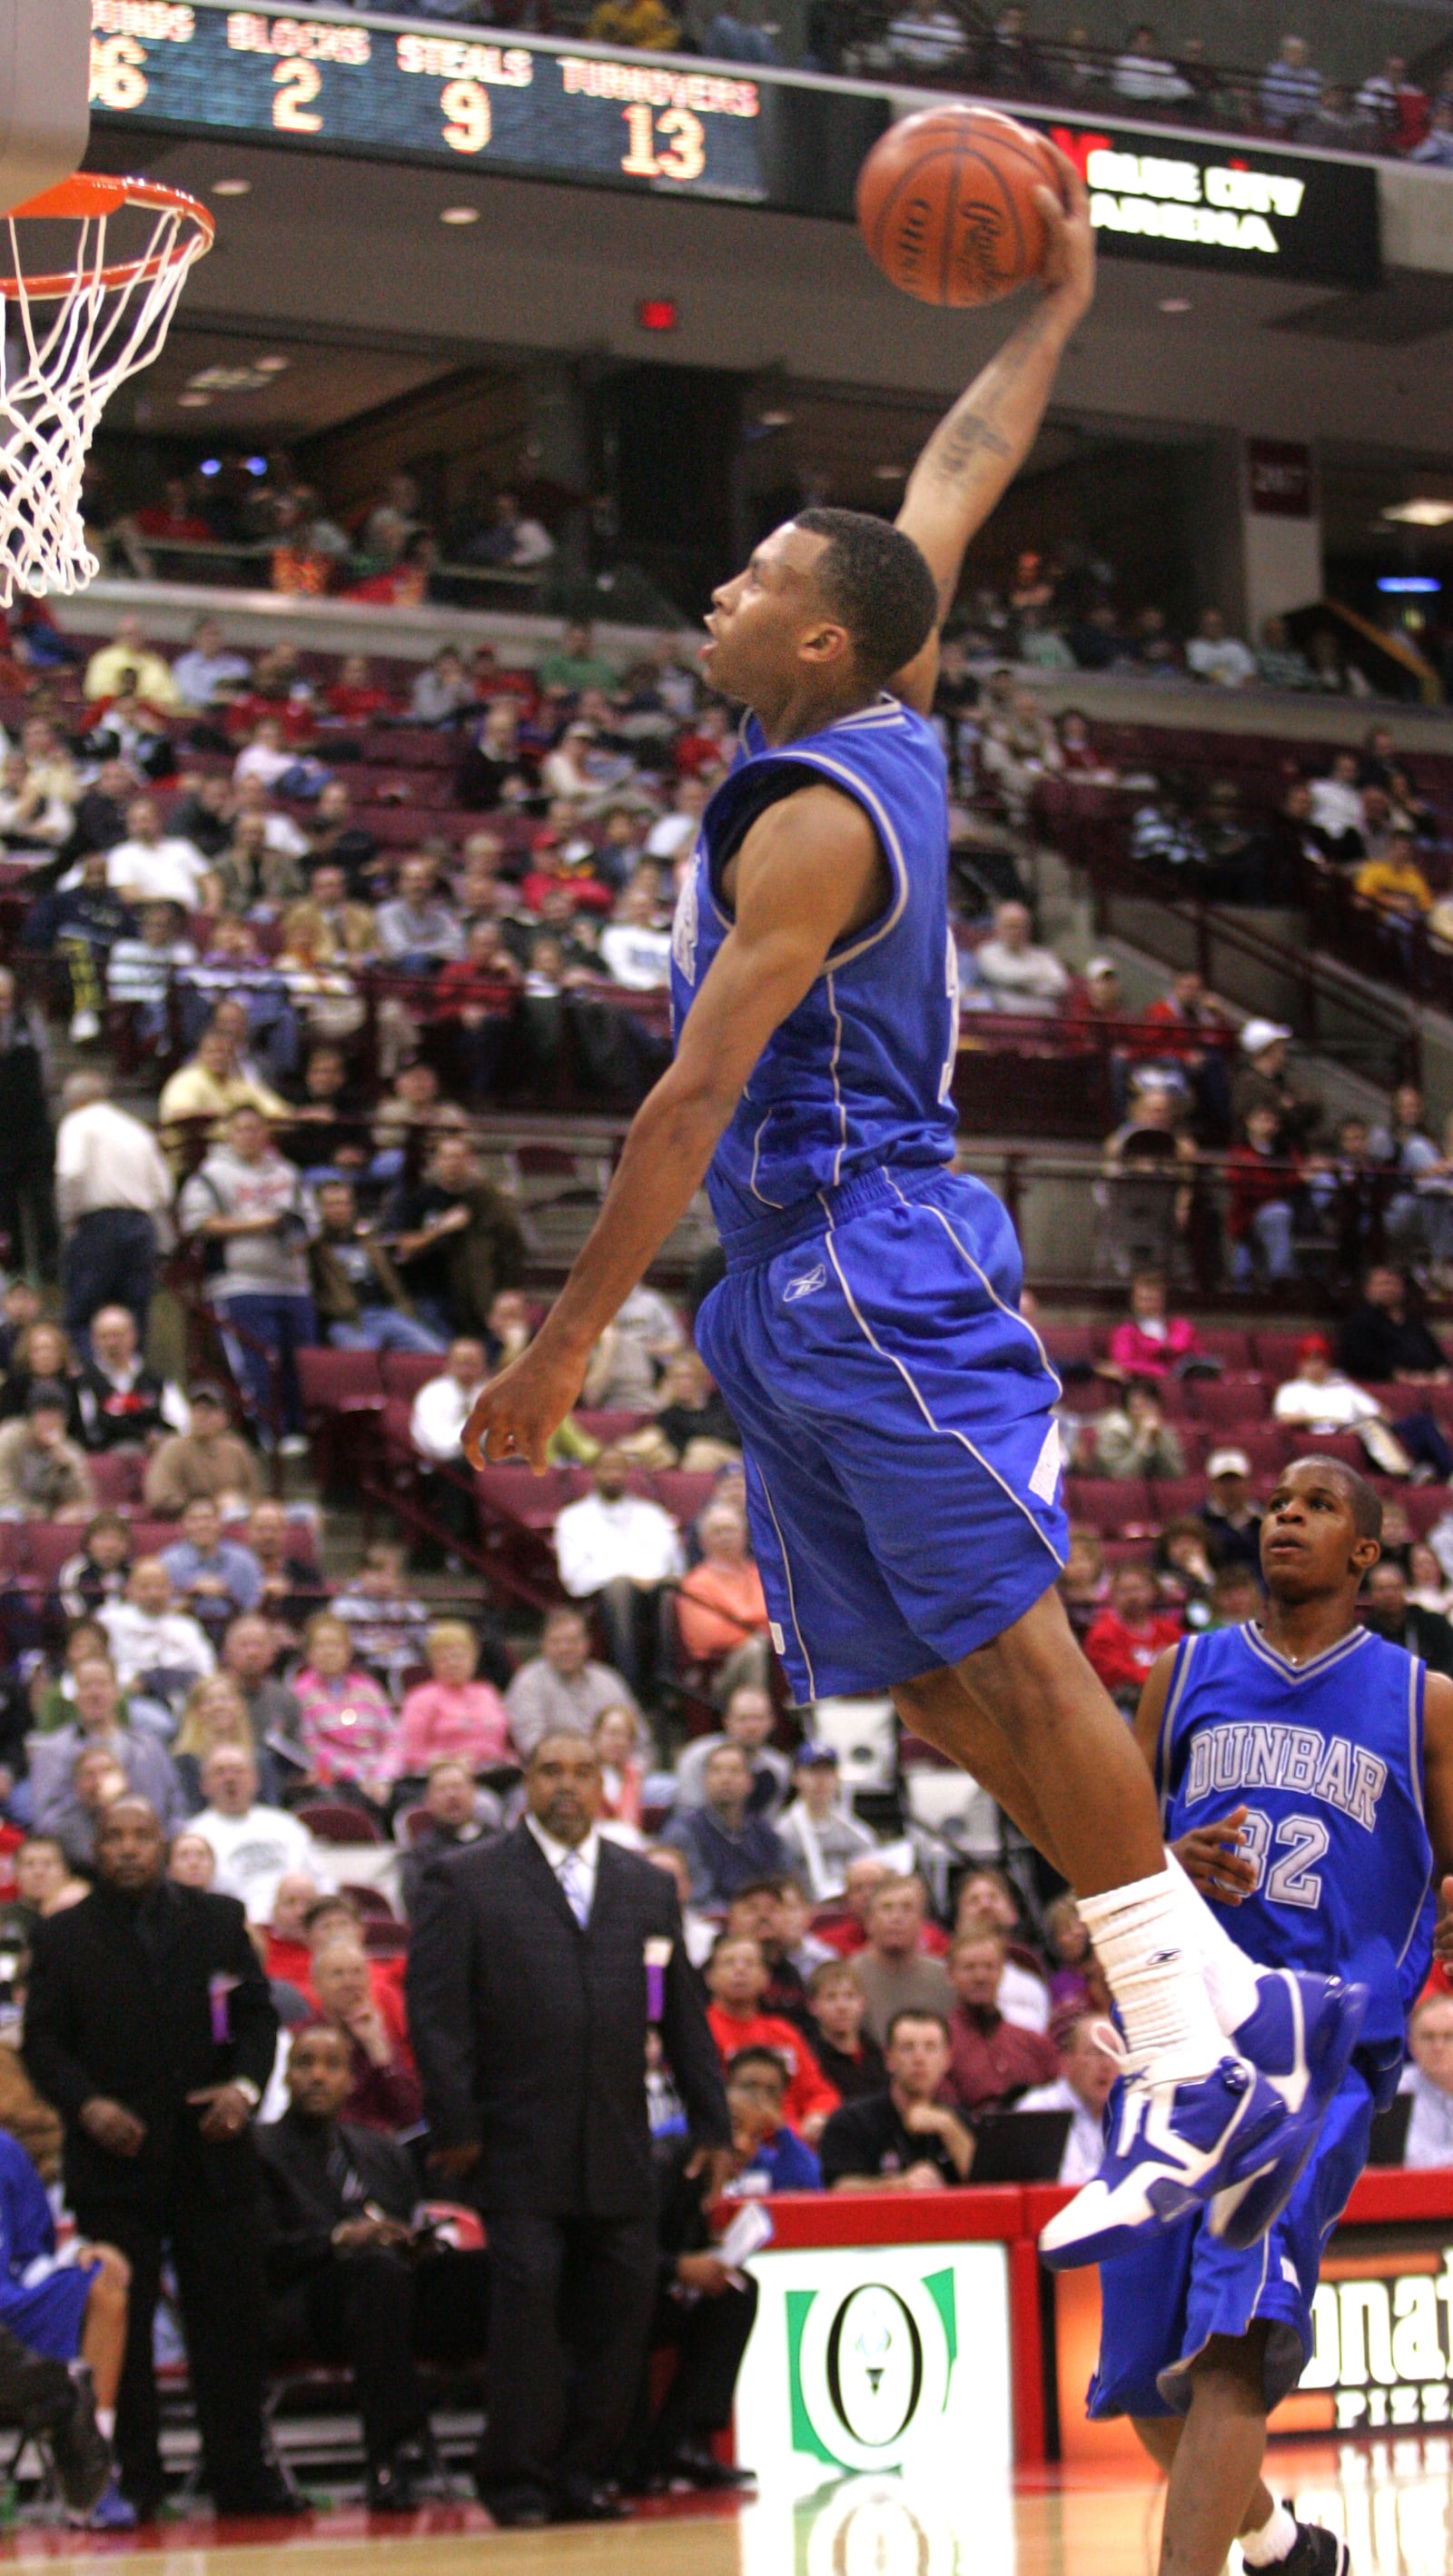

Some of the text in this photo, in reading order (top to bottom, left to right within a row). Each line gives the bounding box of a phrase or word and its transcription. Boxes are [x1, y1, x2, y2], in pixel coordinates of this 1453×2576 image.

[227, 11, 371, 64] BLOCKS
[396, 35, 534, 87] STEALS
[556, 55, 760, 117] TURNOVERS
[272, 57, 324, 134] 2
[440, 79, 492, 154] 9
[620, 104, 706, 180] 13
[1090, 192, 1279, 253] ARENA
[1204, 164, 1305, 217] CITY
[1185, 1720, 1389, 1835] DUNBAR
[1213, 1808, 1329, 1910] 32
